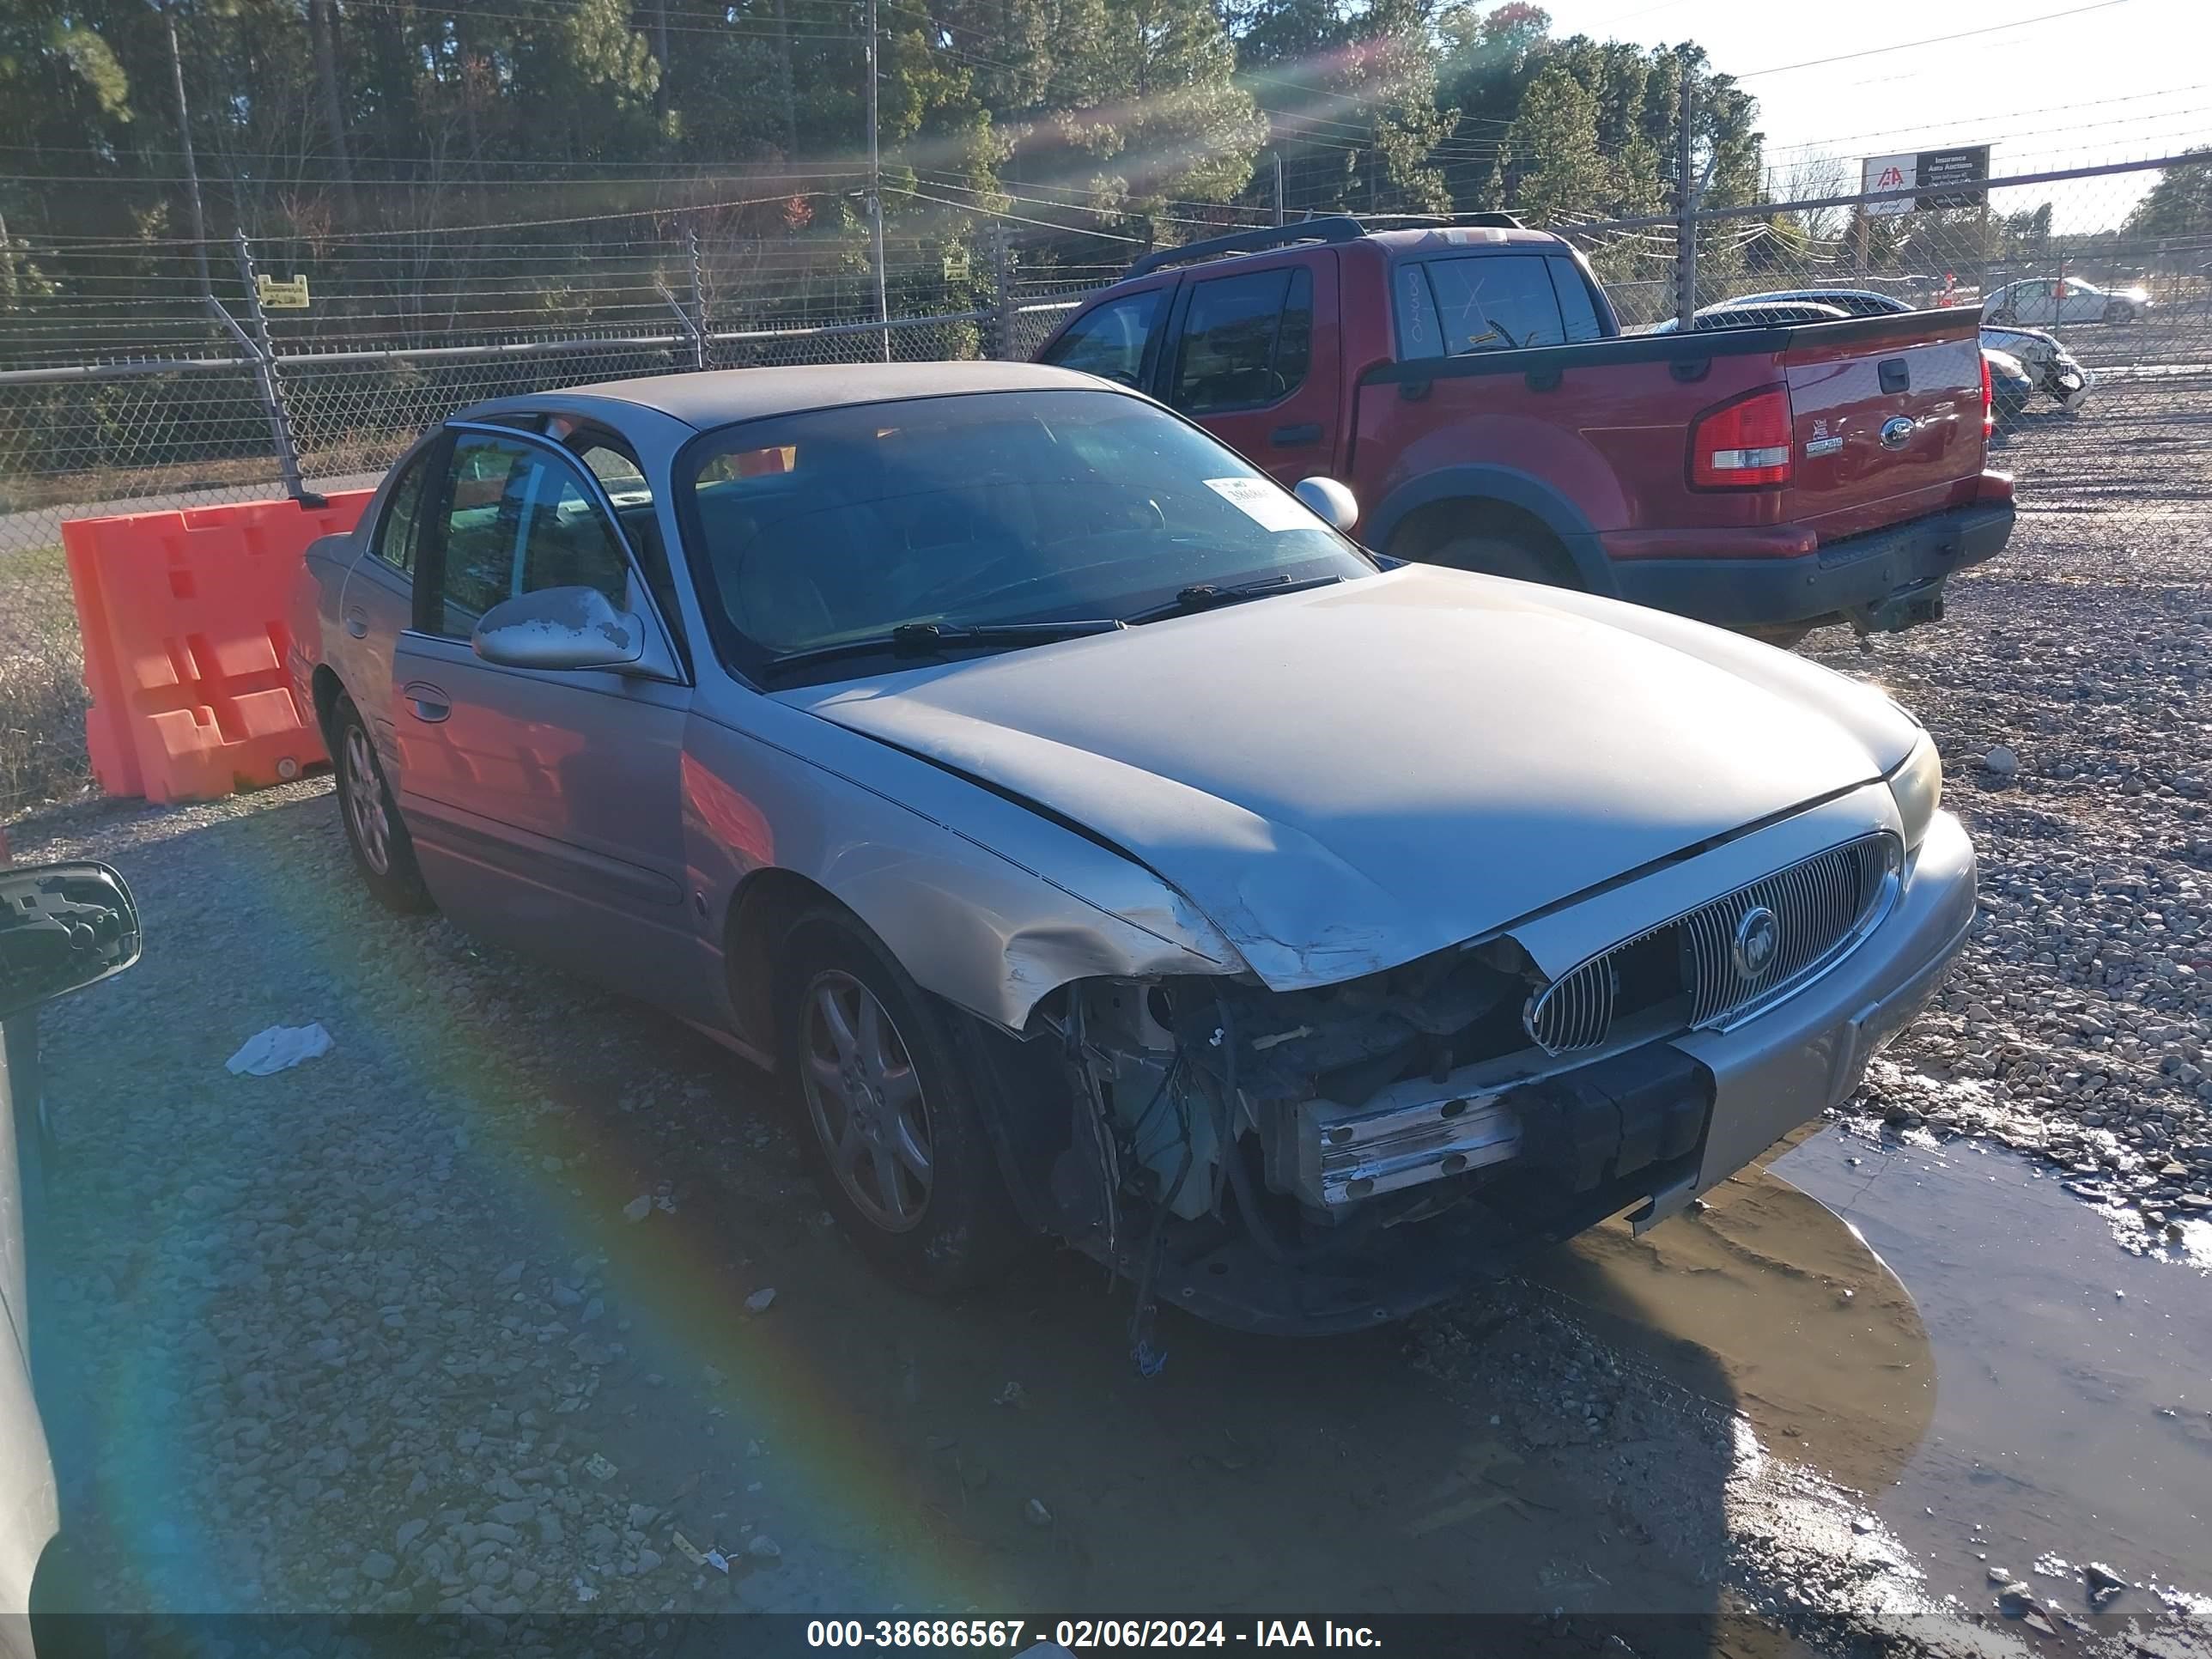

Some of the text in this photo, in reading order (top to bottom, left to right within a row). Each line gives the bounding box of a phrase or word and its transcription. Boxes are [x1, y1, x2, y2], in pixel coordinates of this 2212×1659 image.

[1936, 155, 1966, 164] Insurance
[1944, 162, 1972, 171] Auctions
[1893, 422, 1913, 440] Ford
